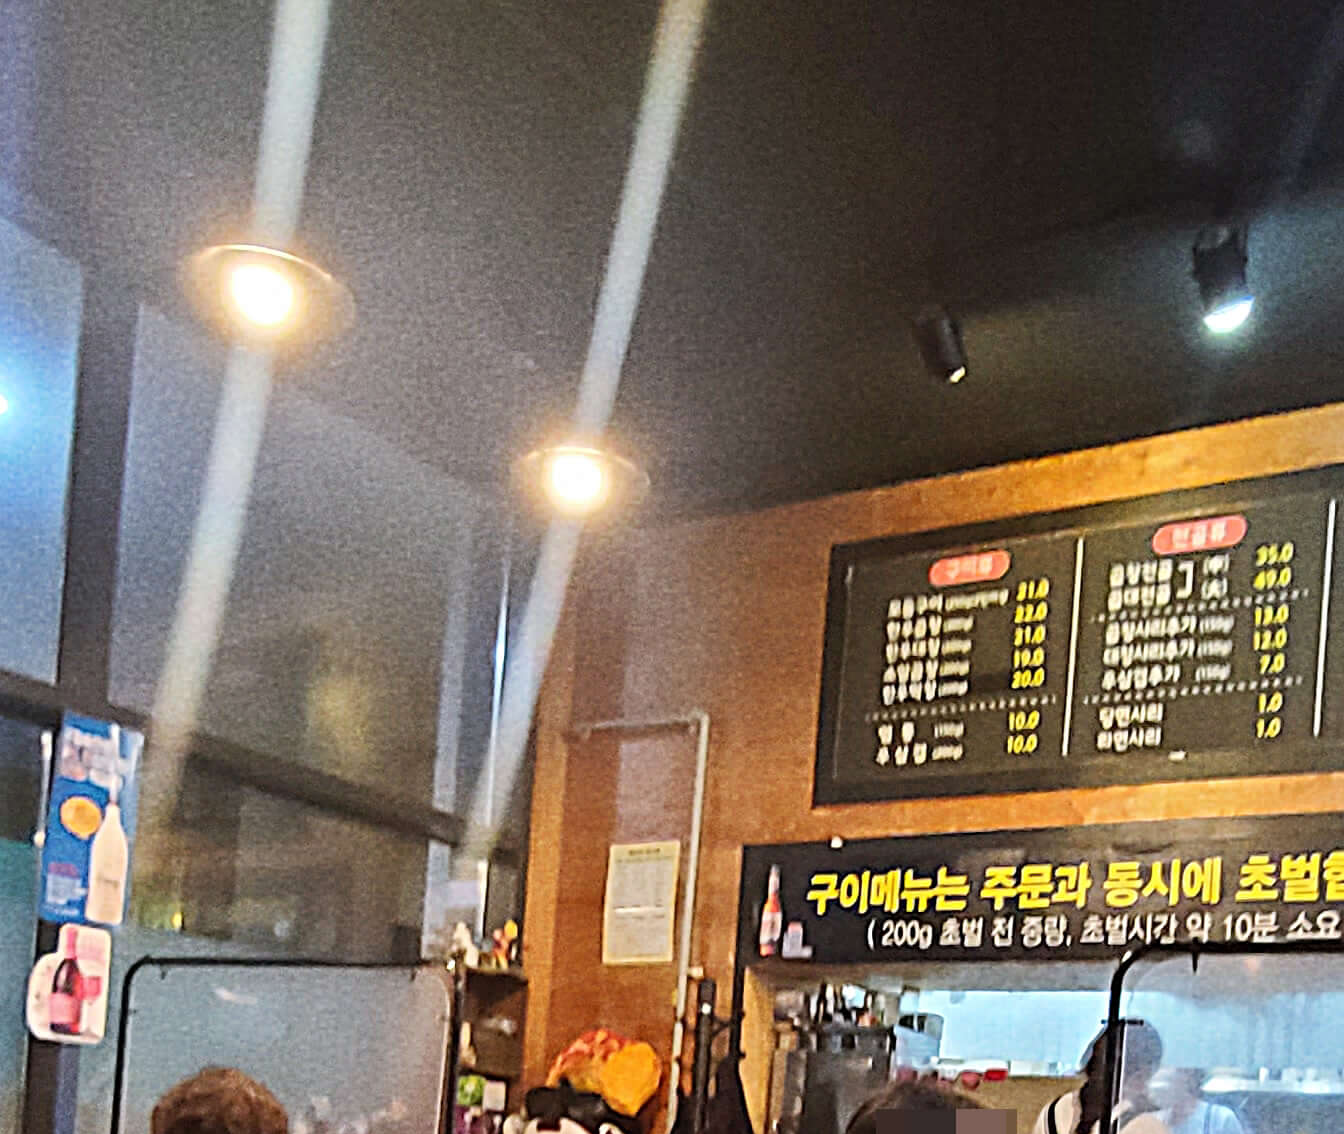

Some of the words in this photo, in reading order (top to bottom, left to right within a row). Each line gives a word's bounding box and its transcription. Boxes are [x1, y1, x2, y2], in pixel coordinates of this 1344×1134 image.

[807, 867, 969, 915] 구이메뉴는
[980, 861, 1092, 911] 주문과
[1103, 855, 1222, 906] 동시에
[939, 915, 983, 948] 초벌
[991, 916, 1014, 947] 전
[1079, 910, 1180, 946] 초벌시간
[1223, 911, 1279, 943] 10분
[1286, 909, 1343, 941] 소요
